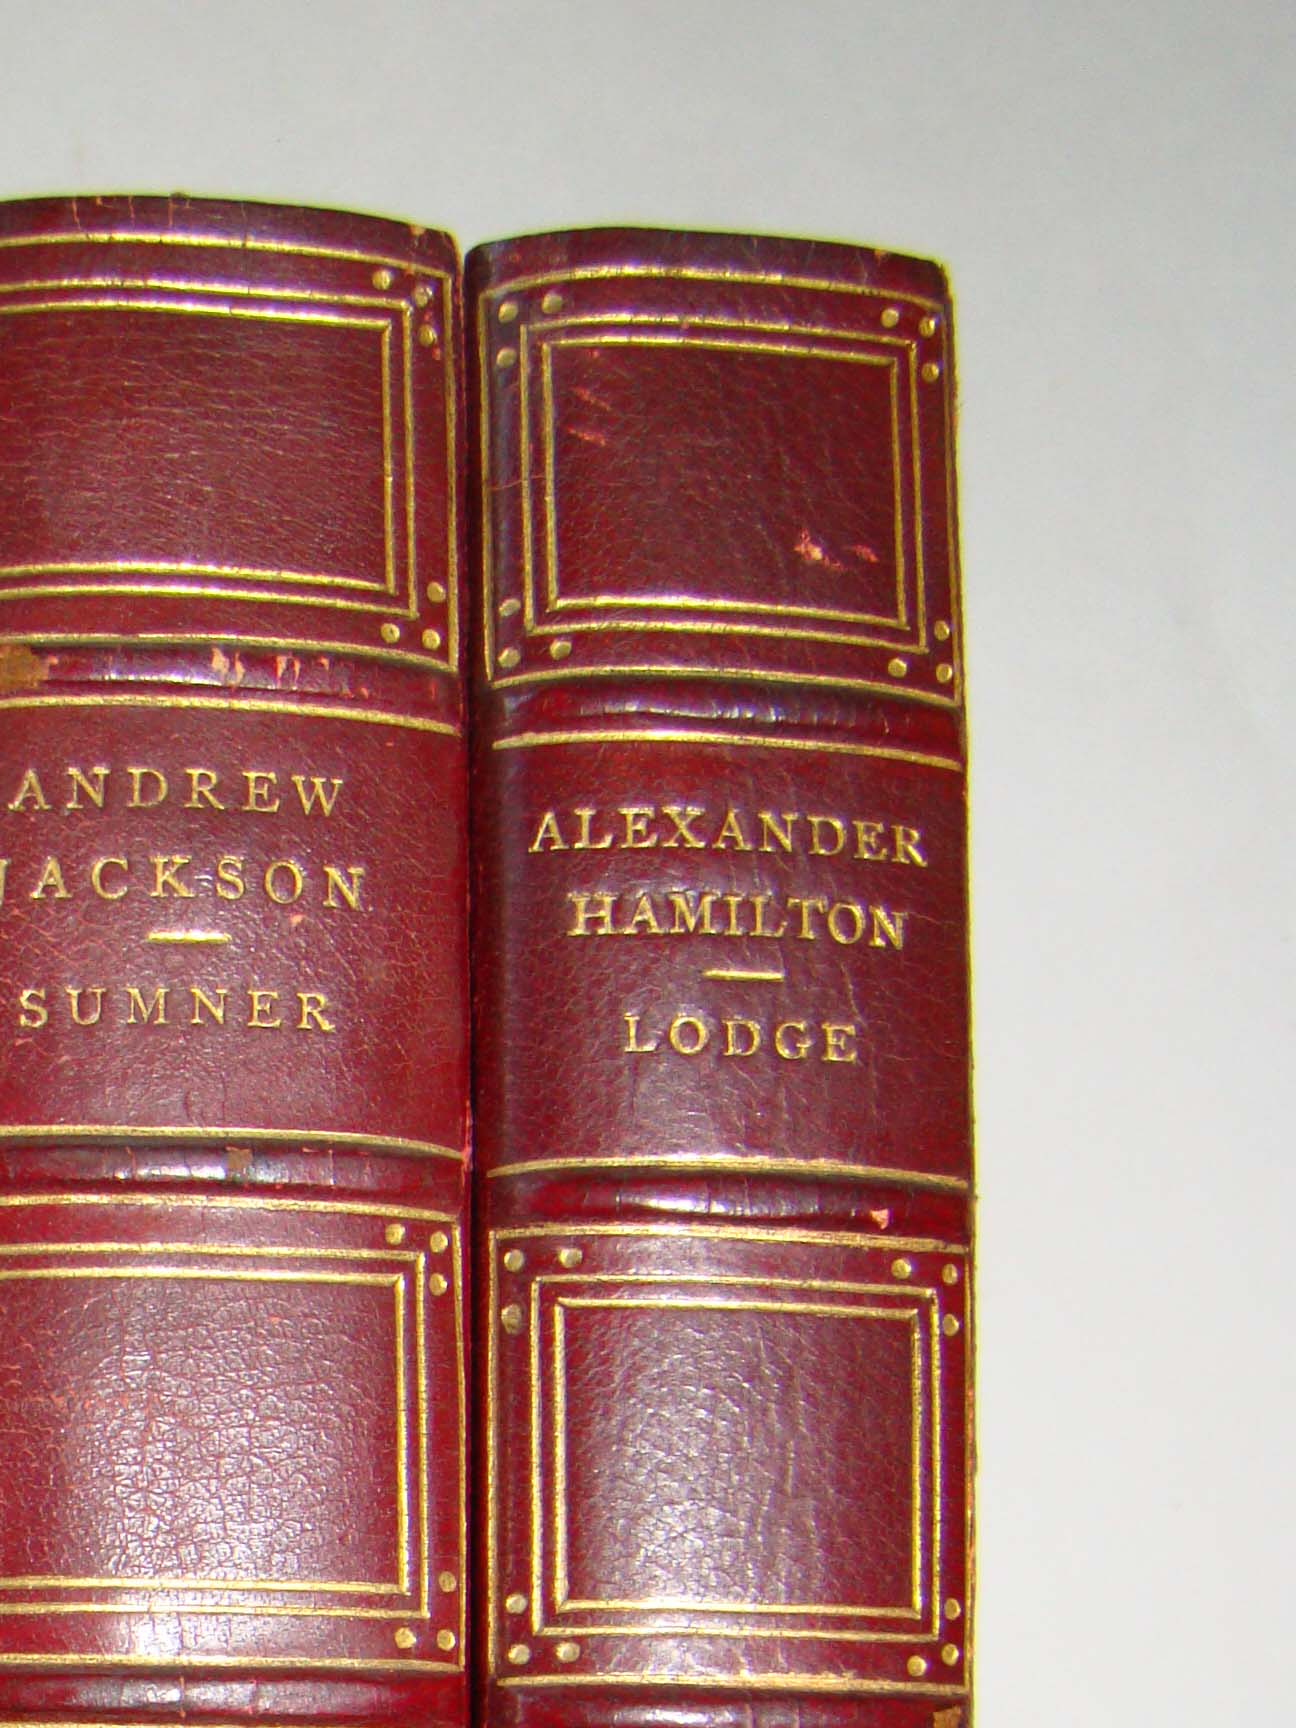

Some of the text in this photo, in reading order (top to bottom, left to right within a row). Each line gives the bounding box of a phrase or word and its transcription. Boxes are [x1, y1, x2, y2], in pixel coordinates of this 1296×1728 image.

[7, 763, 344, 816] ANDREW
[527, 805, 928, 868] ALEXANDER
[566, 891, 907, 950] HAMILTON
[18, 987, 335, 1033] SUMNER
[623, 1013, 857, 1064] LODGE
